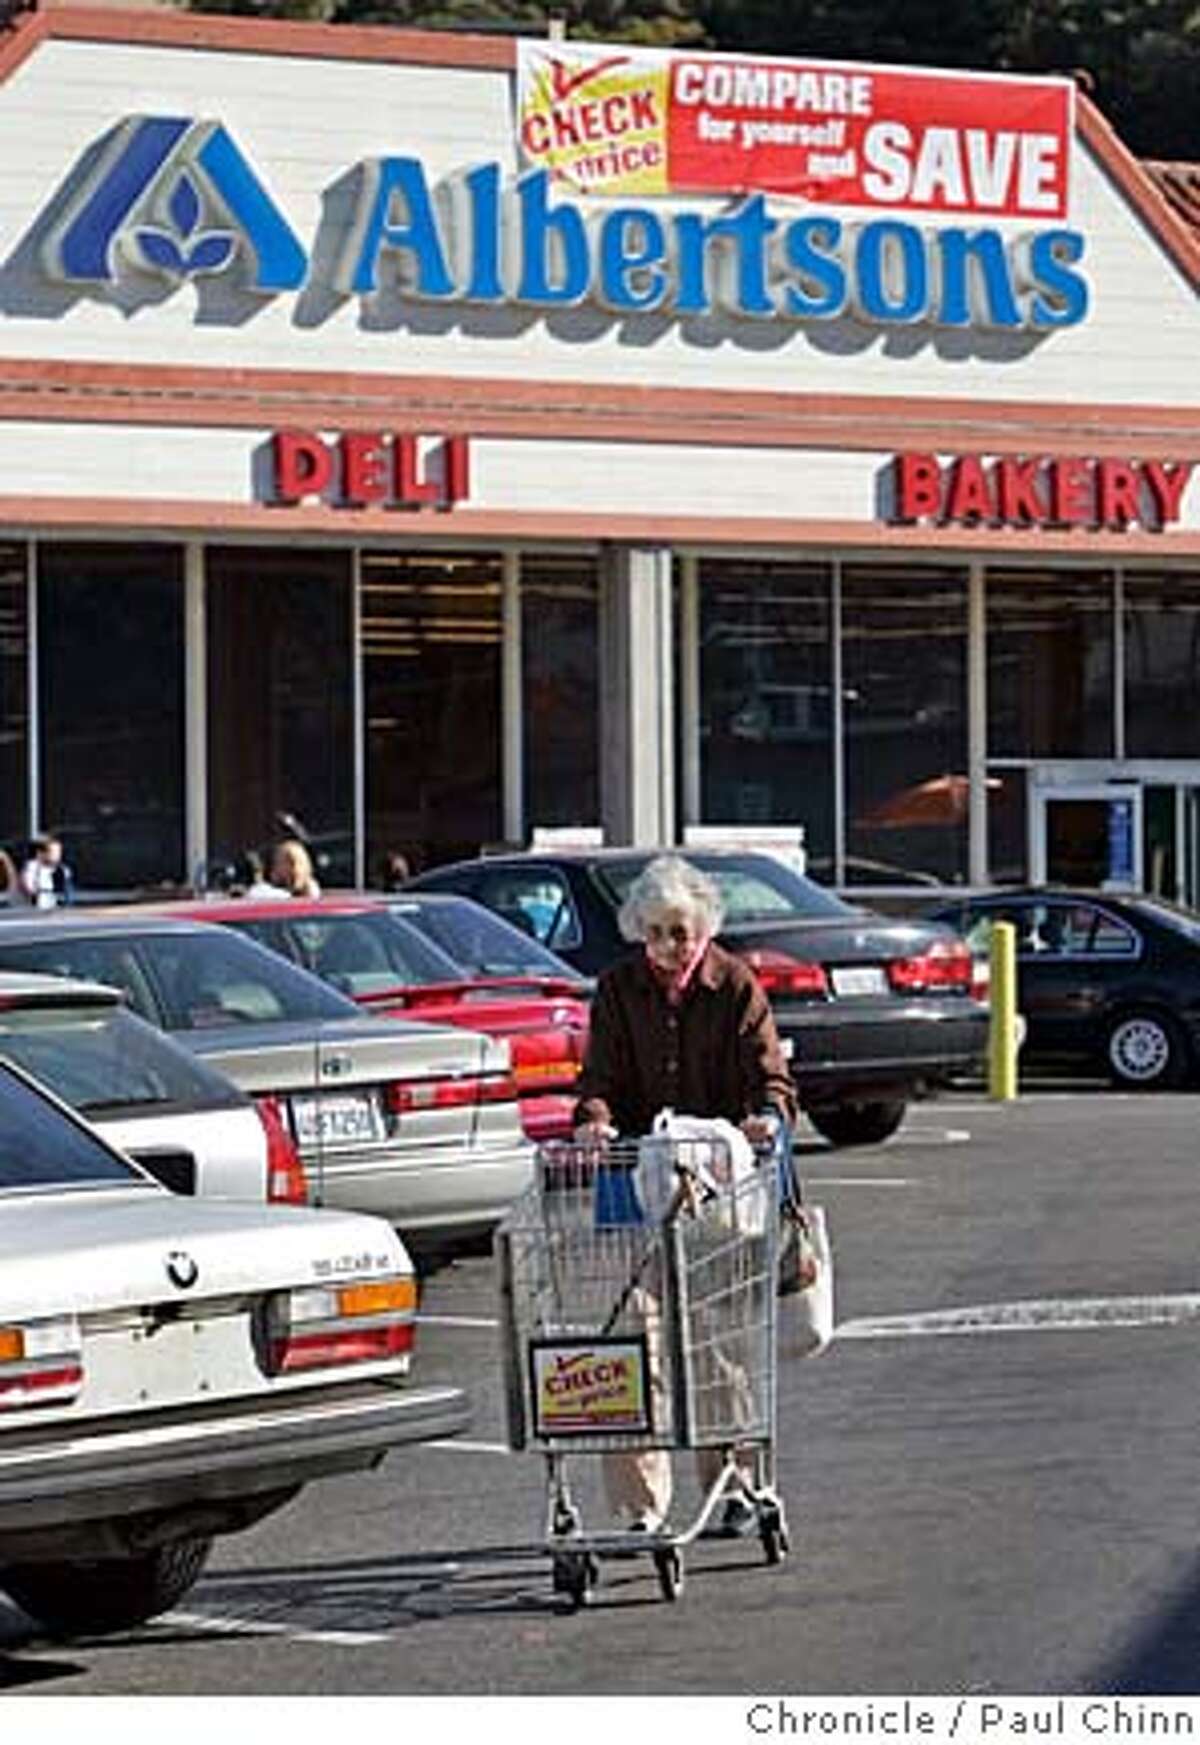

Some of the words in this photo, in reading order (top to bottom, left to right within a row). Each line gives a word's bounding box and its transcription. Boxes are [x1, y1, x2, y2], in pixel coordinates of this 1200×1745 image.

[521, 91, 658, 154] CHECK
[675, 63, 874, 117] COMPARE
[698, 111, 736, 143] for
[741, 118, 847, 150] yourself
[807, 148, 857, 178] and
[862, 121, 1060, 211] SAVE
[351, 155, 1090, 328] Albertsons
[272, 432, 470, 505] DELI
[896, 452, 1192, 525] BAKERY
[545, 1358, 627, 1395] CHECK
